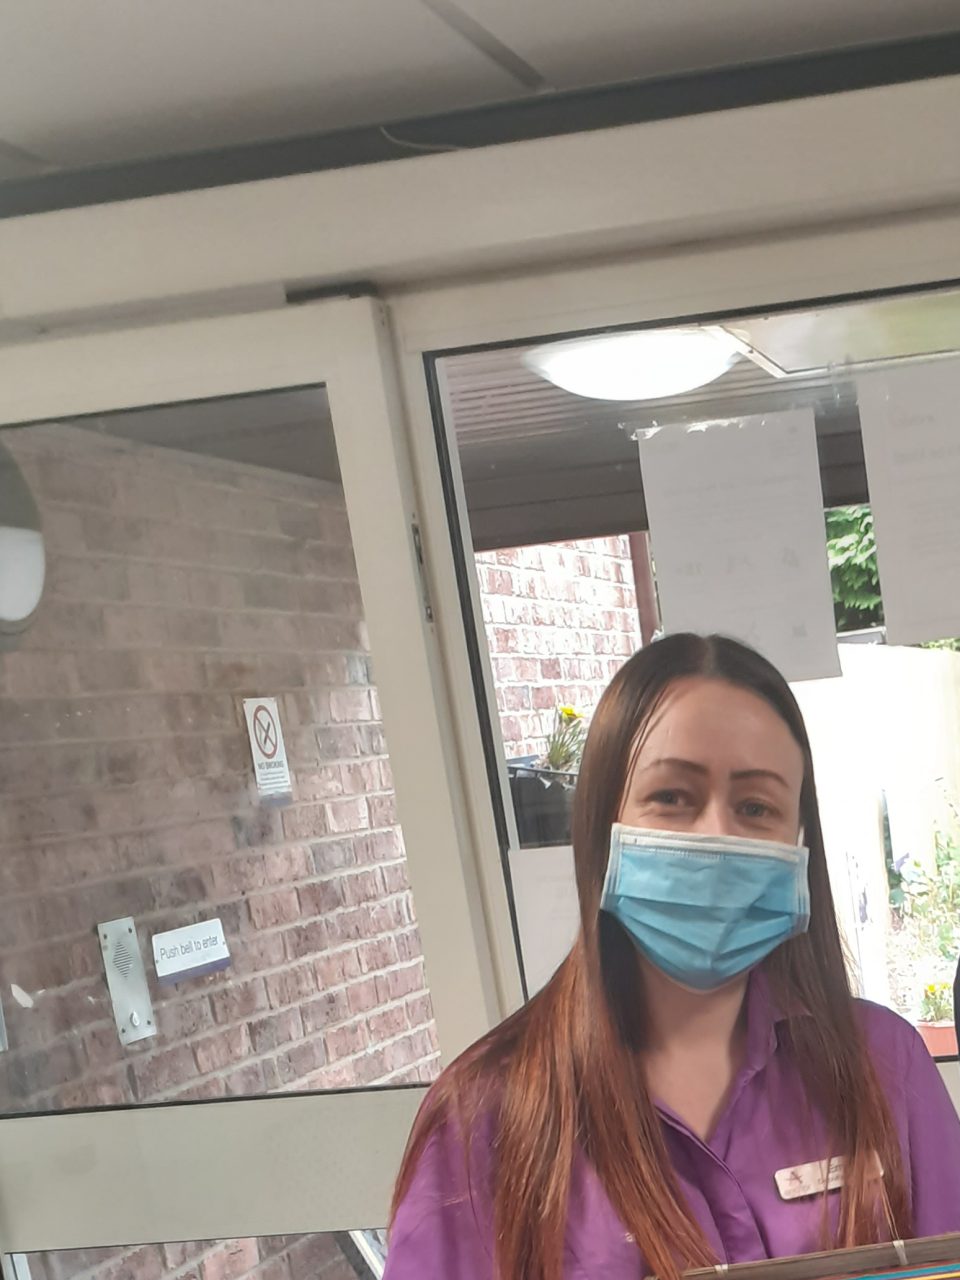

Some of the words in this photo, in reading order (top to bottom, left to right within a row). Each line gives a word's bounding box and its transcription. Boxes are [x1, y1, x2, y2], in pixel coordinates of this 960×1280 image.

[160, 945, 180, 960] Push
[180, 940, 193, 955] bell
[194, 940, 202, 951] to
[202, 936, 218, 949] enter
